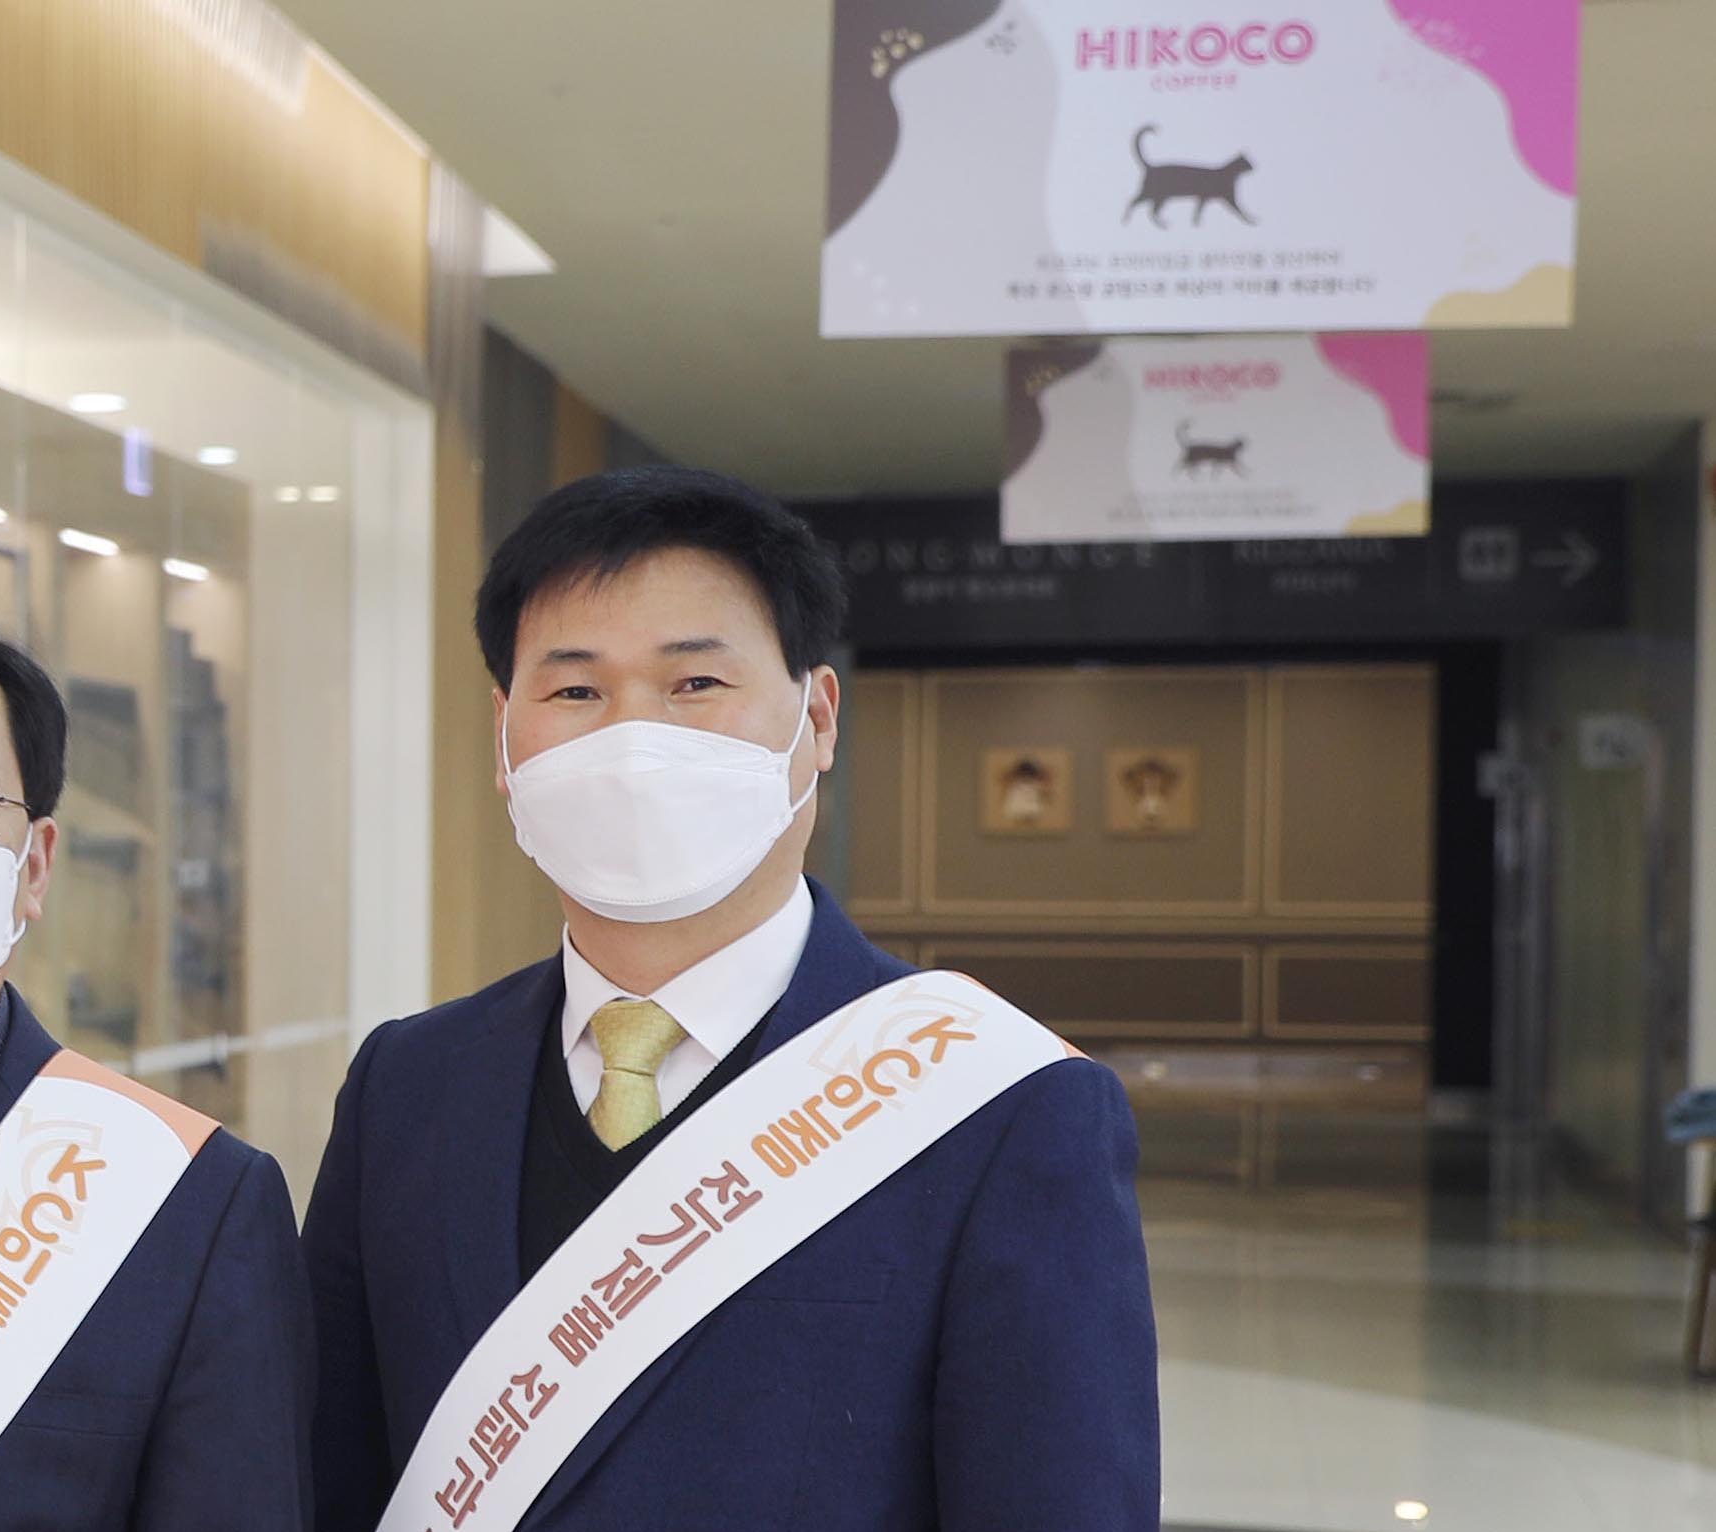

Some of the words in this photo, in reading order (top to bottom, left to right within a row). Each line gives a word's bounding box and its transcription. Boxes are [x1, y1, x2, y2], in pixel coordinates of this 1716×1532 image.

[1077, 20, 1316, 70] HIKOCO
[751, 1014, 976, 1180] KC인증
[546, 1158, 764, 1369] 전기제품
[433, 1362, 561, 1530] 선택과
